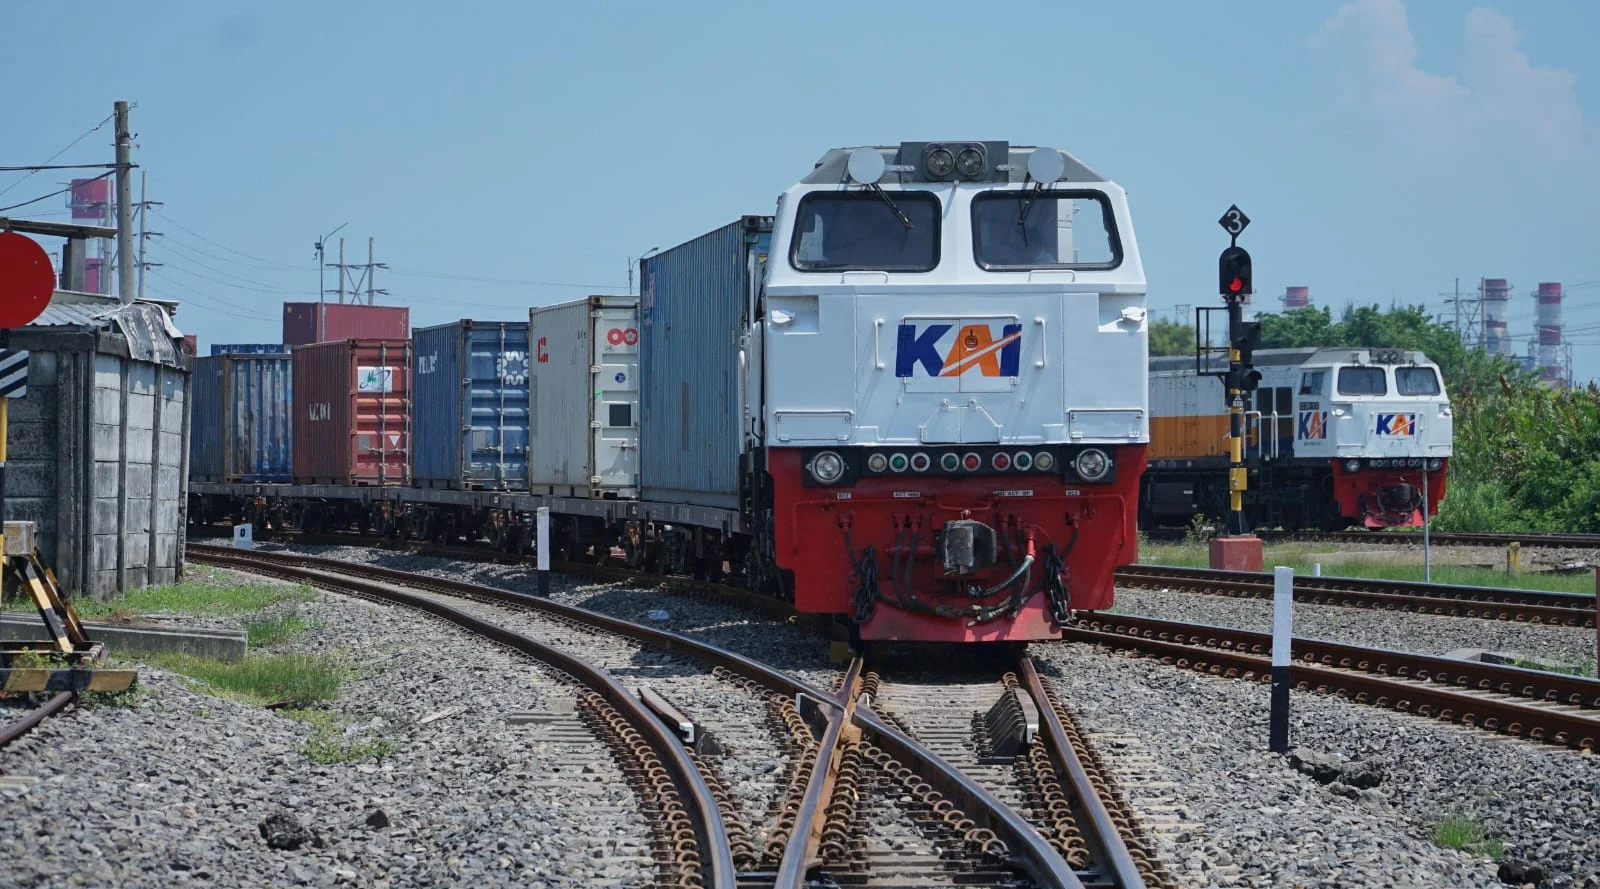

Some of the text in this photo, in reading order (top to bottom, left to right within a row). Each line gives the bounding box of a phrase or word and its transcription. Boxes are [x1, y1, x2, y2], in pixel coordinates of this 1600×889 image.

[1227, 210, 1242, 233] 3
[896, 323, 1022, 377] KAI
[1298, 411, 1328, 441] KAI
[1375, 414, 1416, 436] KAI
[240, 528, 246, 538] 0
